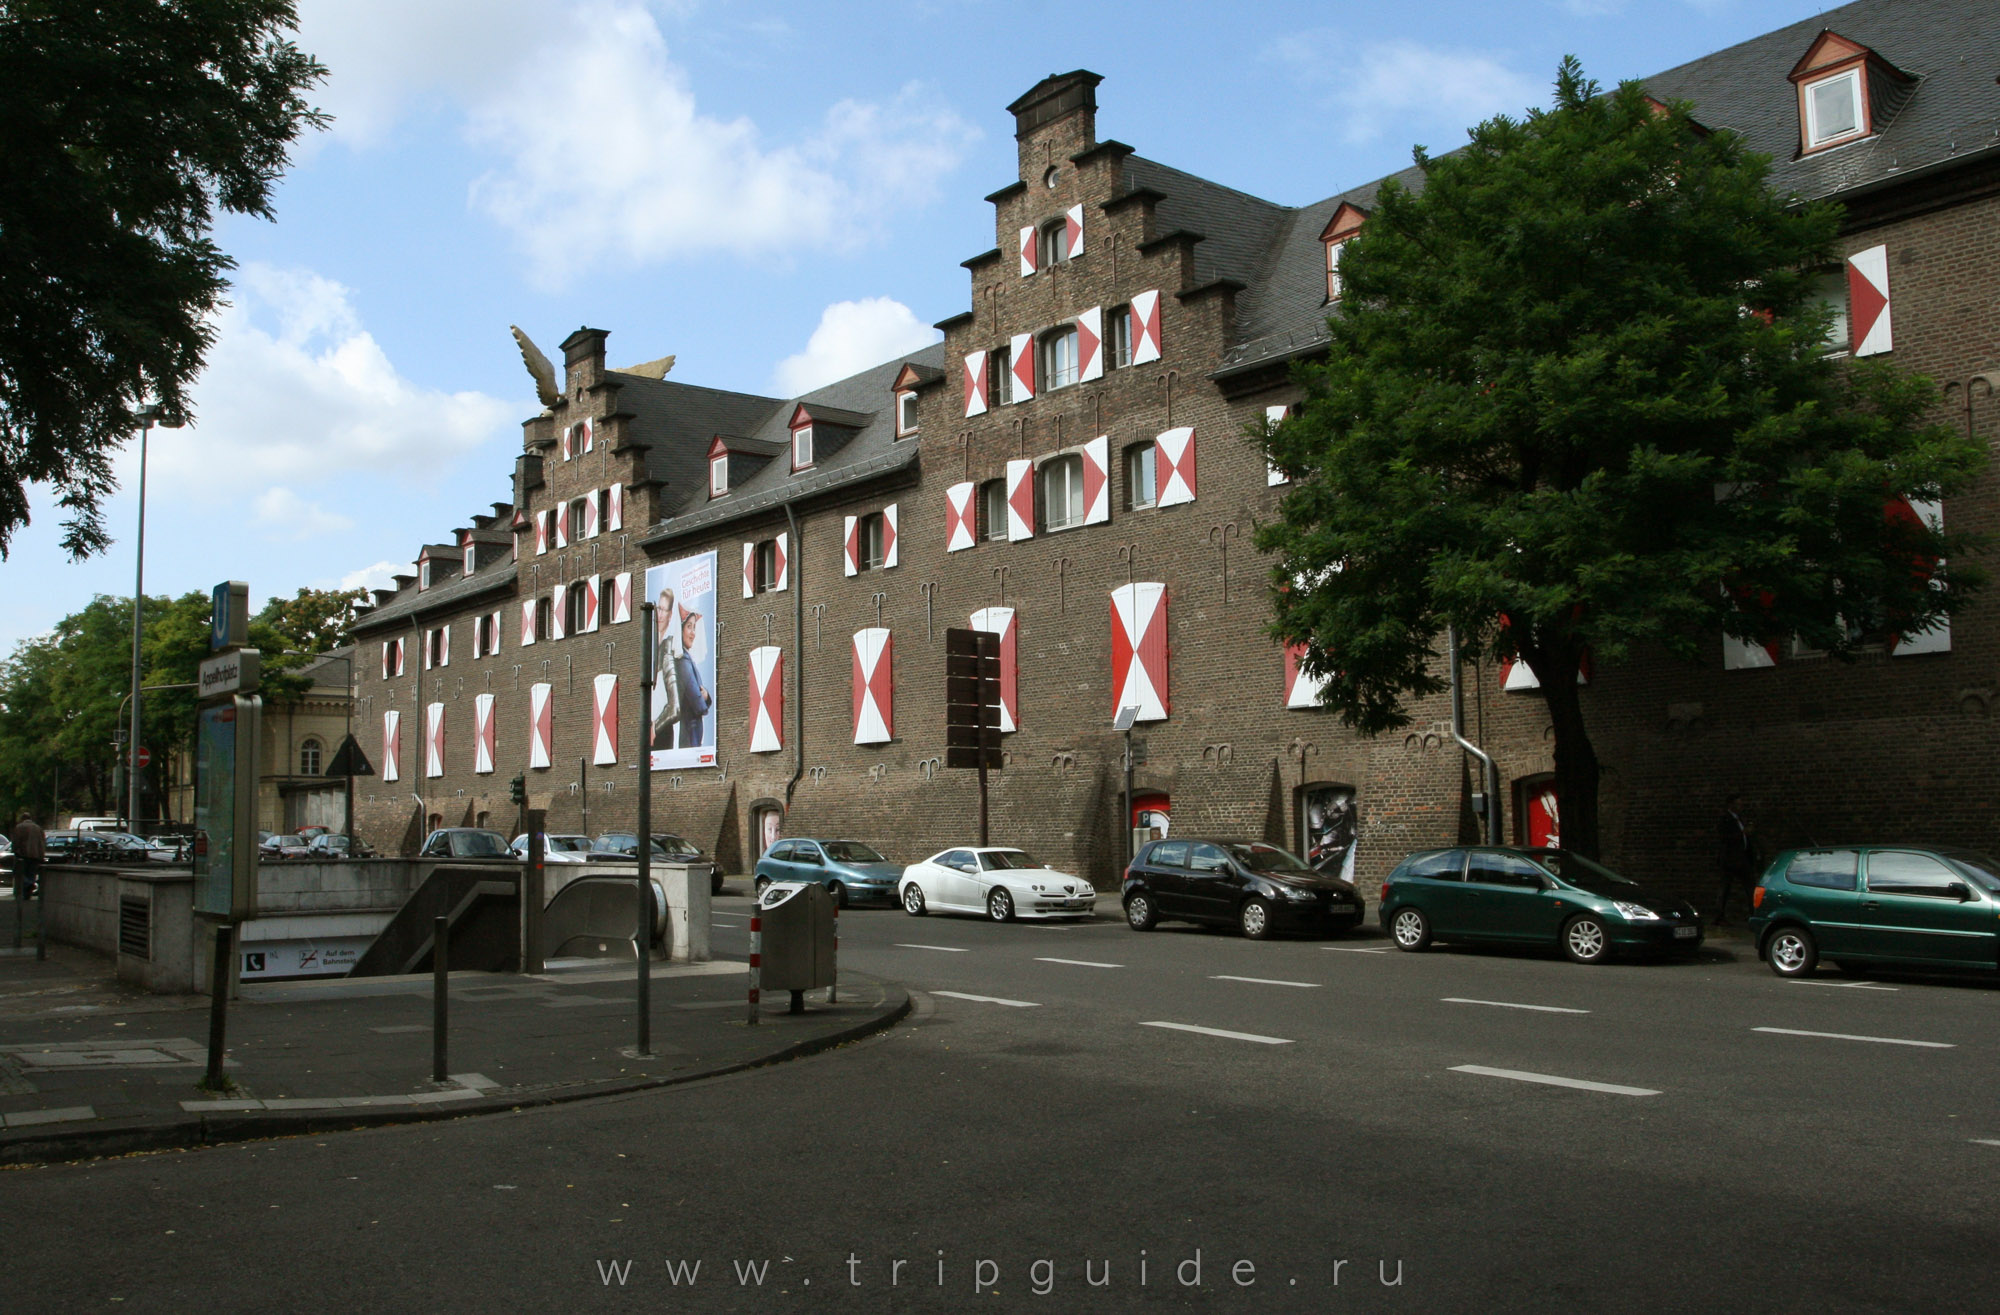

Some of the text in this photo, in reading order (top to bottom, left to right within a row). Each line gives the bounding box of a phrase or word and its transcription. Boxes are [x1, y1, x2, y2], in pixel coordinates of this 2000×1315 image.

[692, 581, 710, 595] heute
[215, 592, 227, 639] U
[202, 664, 237, 689] Appellhofplatz
[1142, 813, 1149, 824] P
[325, 949, 338, 957] Auf
